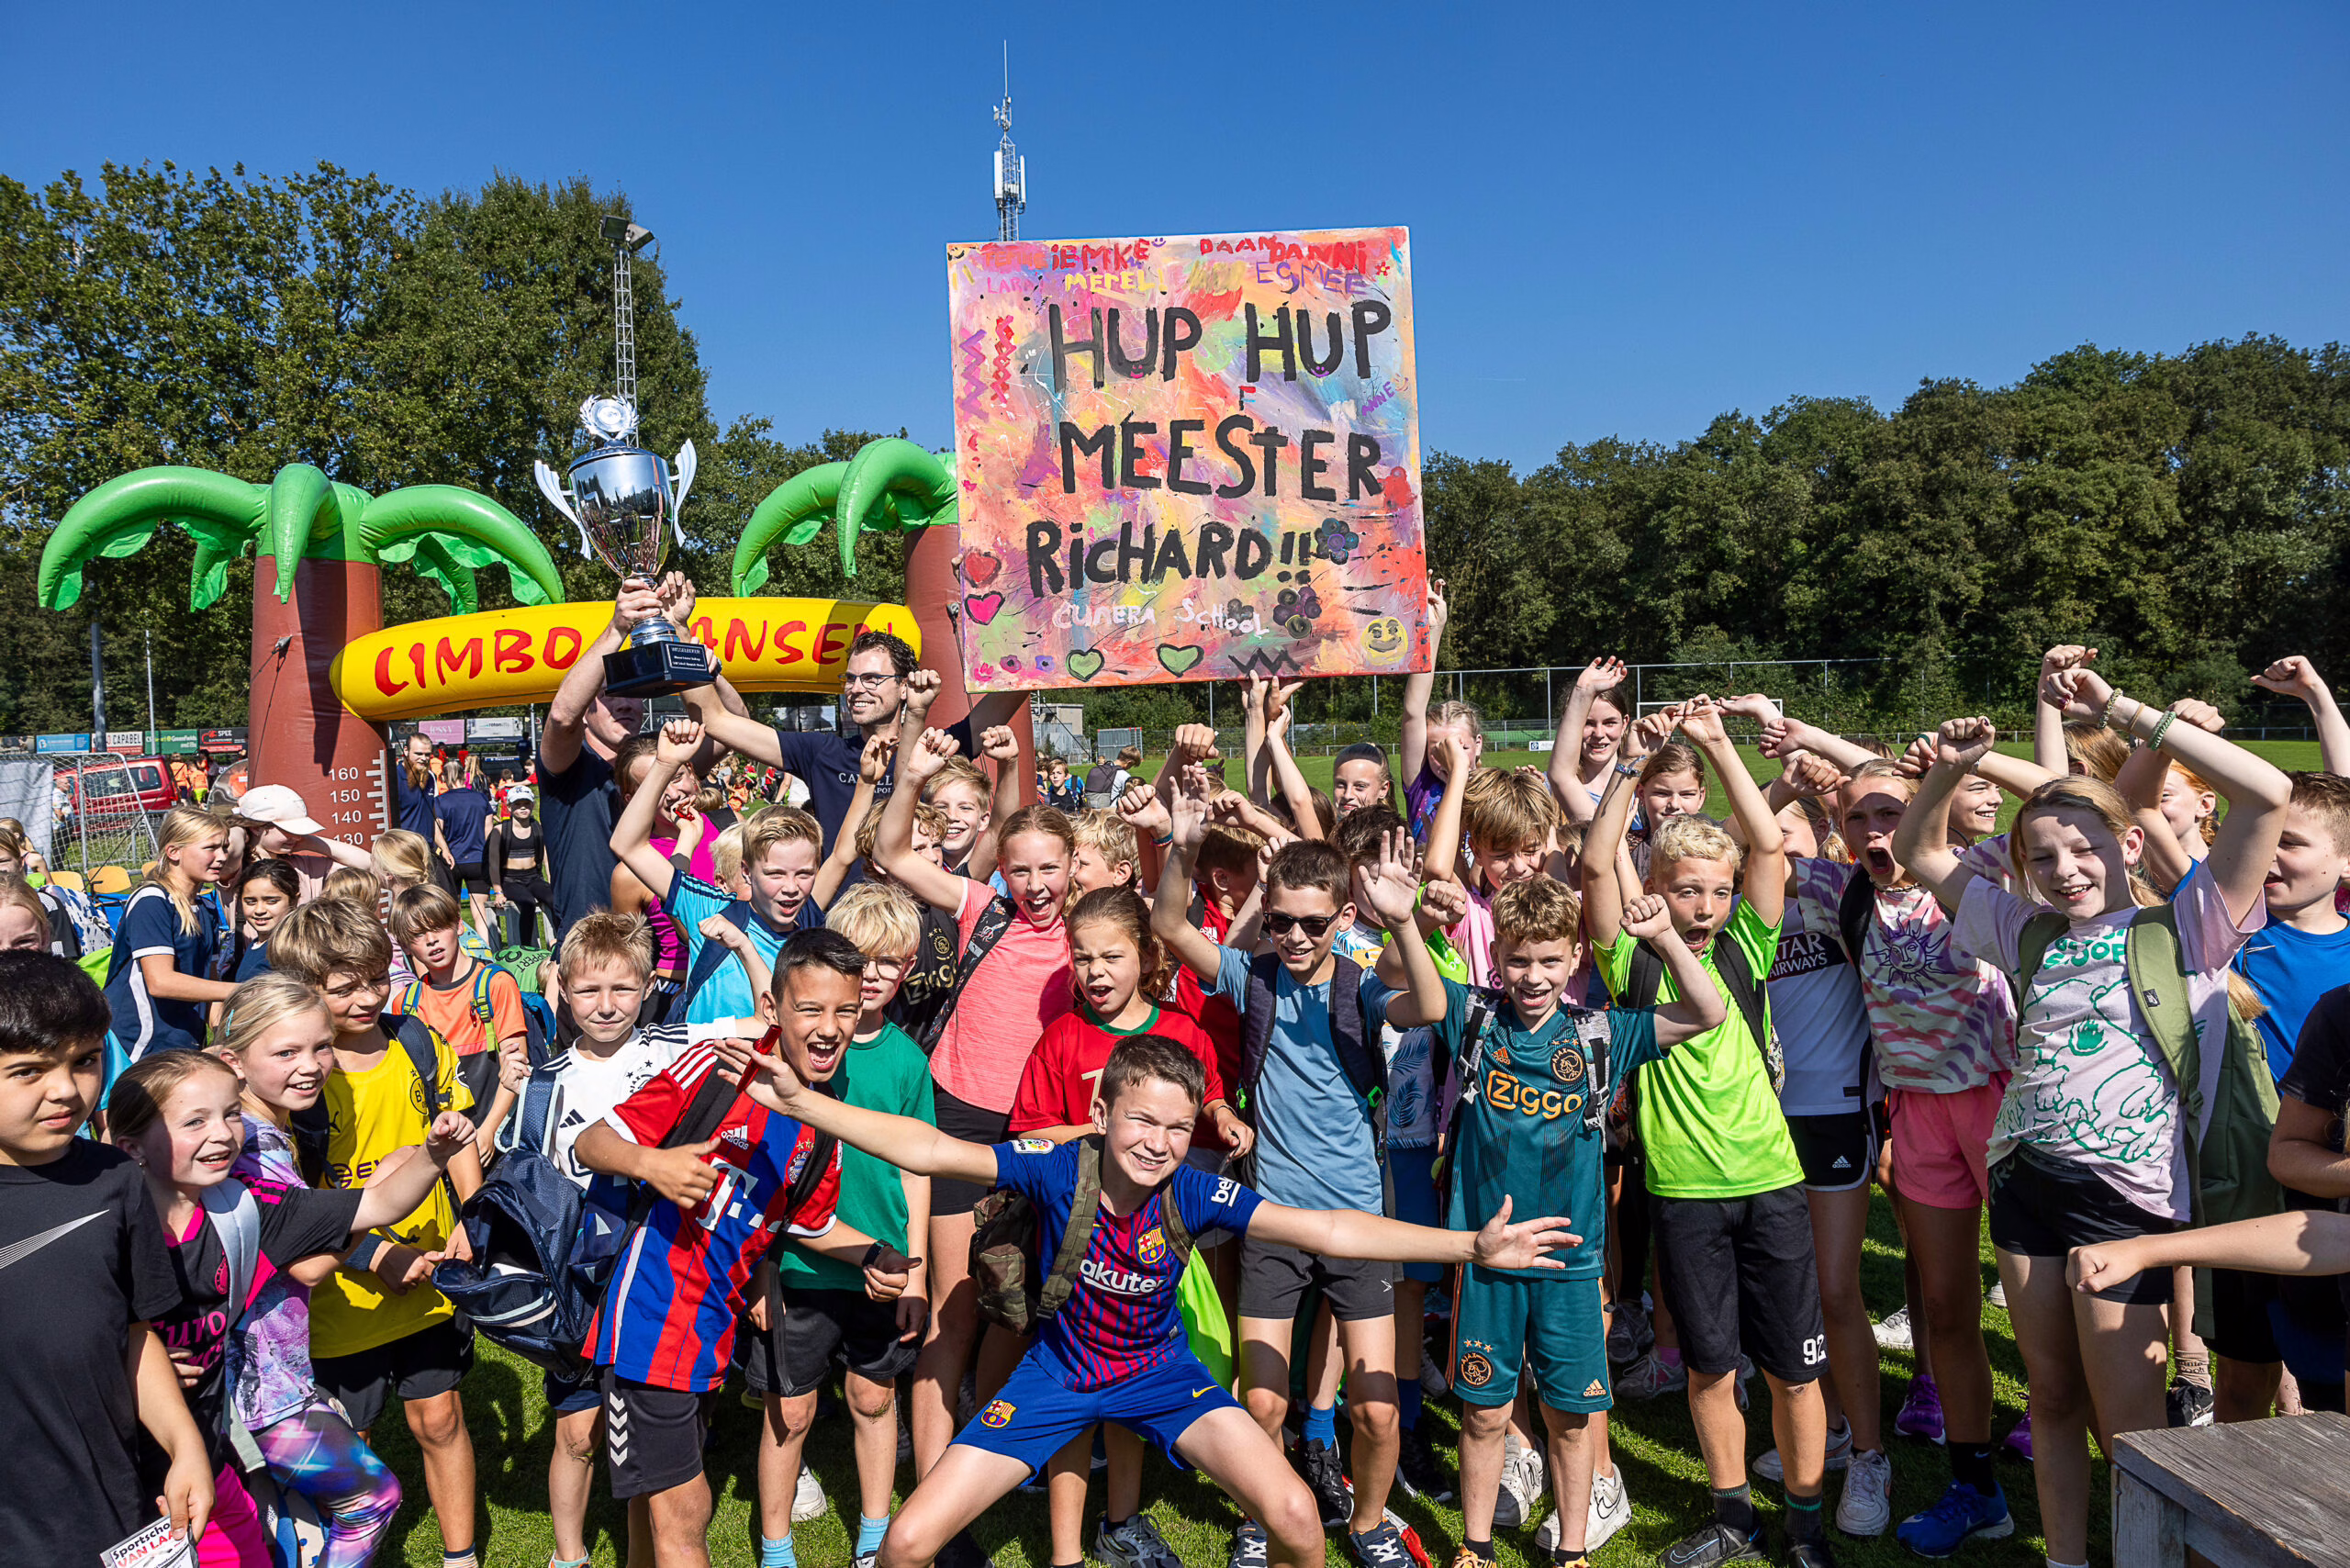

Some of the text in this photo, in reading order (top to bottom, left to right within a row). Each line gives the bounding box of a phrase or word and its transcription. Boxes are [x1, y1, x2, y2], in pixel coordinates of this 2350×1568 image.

[1049, 299, 1392, 394] HUP HUP
[375, 627, 583, 698] LIMBO
[329, 767, 359, 781] 160
[330, 789, 361, 803] 150
[331, 810, 362, 824] 140
[1775, 933, 1826, 961] TAR
[1769, 952, 1828, 979] AIRWAYS
[1081, 1068, 1105, 1117] 7
[721, 1130, 750, 1150] adidas
[1080, 1259, 1169, 1294] akute
[1803, 1334, 1827, 1365] 92
[1583, 1389, 1607, 1397] adidas
[113, 1522, 171, 1560] Sportscho
[118, 1546, 148, 1567] VAN
[150, 1530, 175, 1551] LAA
